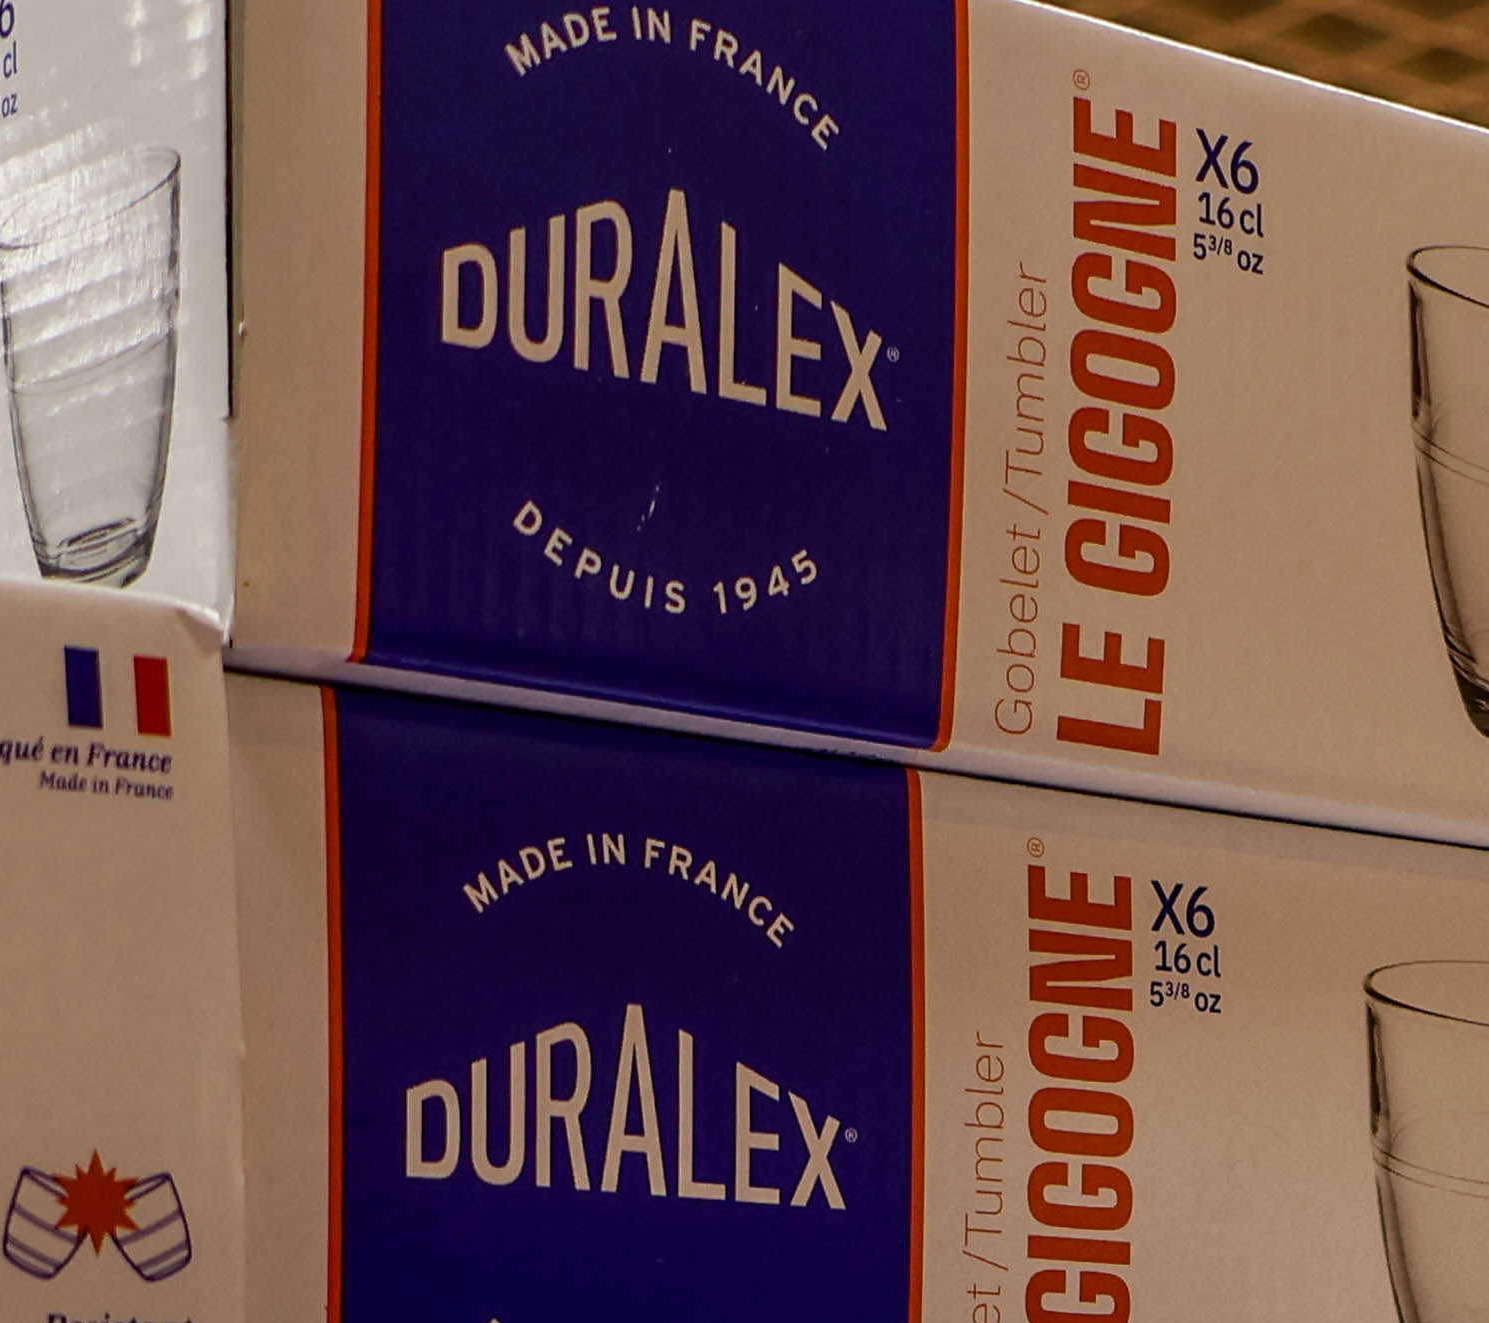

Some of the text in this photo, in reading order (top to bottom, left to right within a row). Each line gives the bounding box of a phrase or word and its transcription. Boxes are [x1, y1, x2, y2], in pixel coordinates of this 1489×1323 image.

[505, 7, 839, 150] MADE IN FRANCE
[1194, 127, 1260, 194] X6
[513, 500, 818, 615] DEPUIS 1945
[1056, 622, 1165, 755] LE
[51, 746, 79, 765] en
[87, 742, 172, 773] France
[462, 833, 795, 948] MADE IN FRANCE
[1151, 880, 1215, 938] X6
